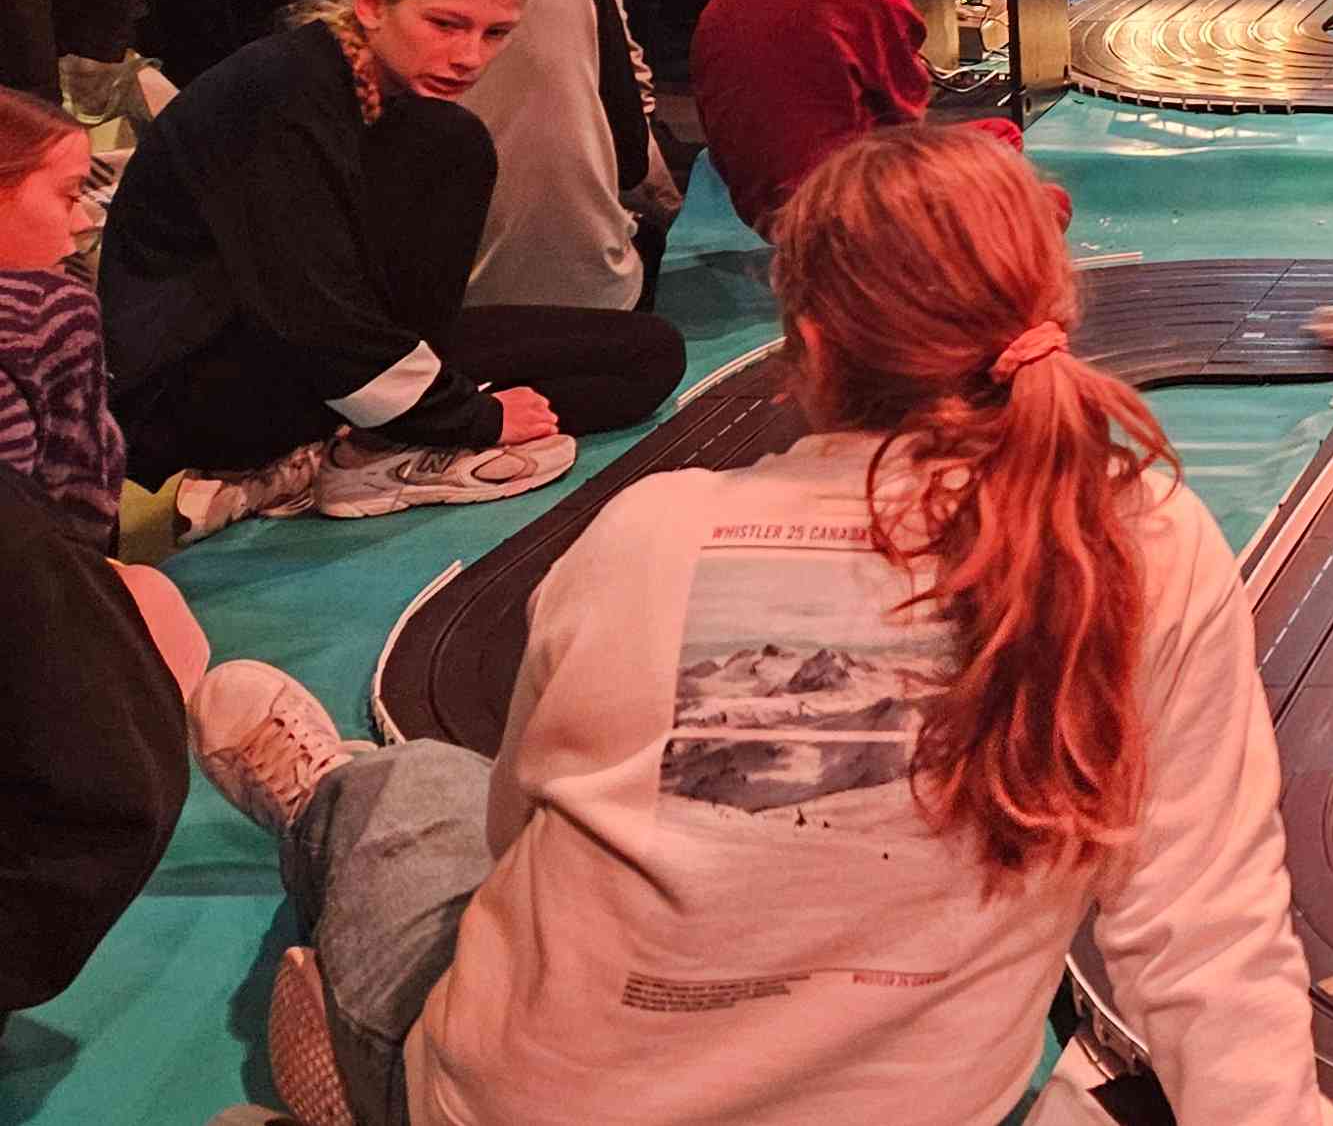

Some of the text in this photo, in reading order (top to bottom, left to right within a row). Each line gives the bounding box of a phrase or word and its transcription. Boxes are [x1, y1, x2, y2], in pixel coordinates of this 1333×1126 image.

[712, 524, 868, 541] WHISTLER 25 CANADA
